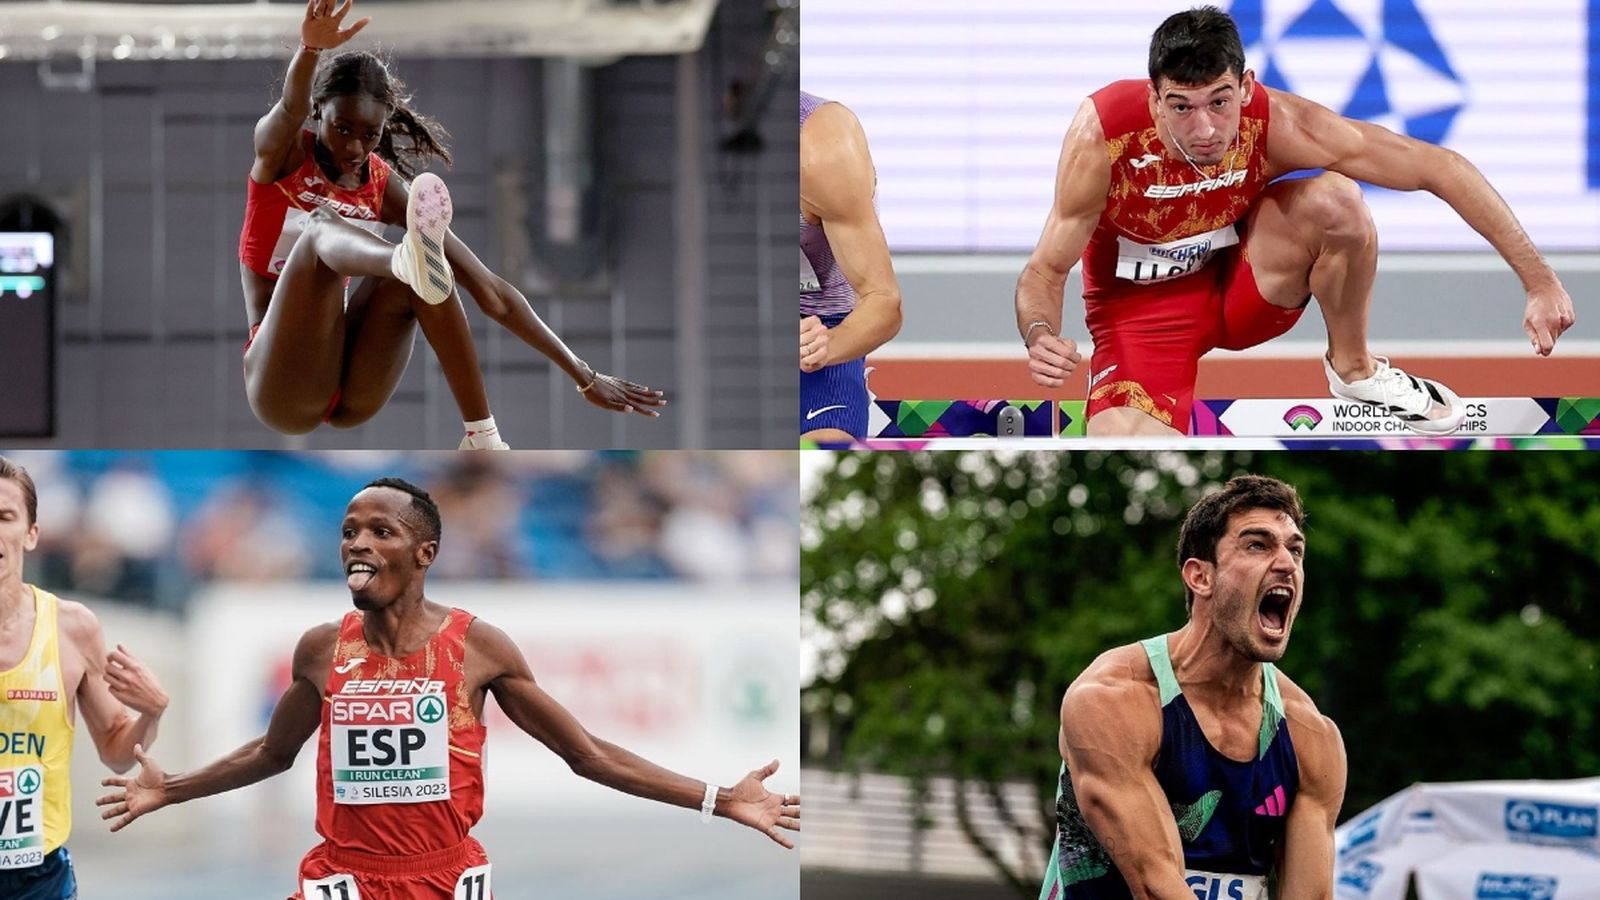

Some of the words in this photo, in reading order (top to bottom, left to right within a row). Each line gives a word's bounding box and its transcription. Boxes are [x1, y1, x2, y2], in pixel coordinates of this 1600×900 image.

[1333, 421, 1381, 431] INDOOR
[340, 677, 445, 694] ESPAÑA
[8, 690, 57, 700] BAUHAUS
[334, 701, 411, 721] SPAR
[347, 728, 426, 766] ESP
[356, 771, 380, 780] RUN
[363, 786, 413, 798] SILESIA
[416, 784, 446, 797] 2023
[14, 852, 42, 864] 2023
[462, 873, 485, 900] 11
